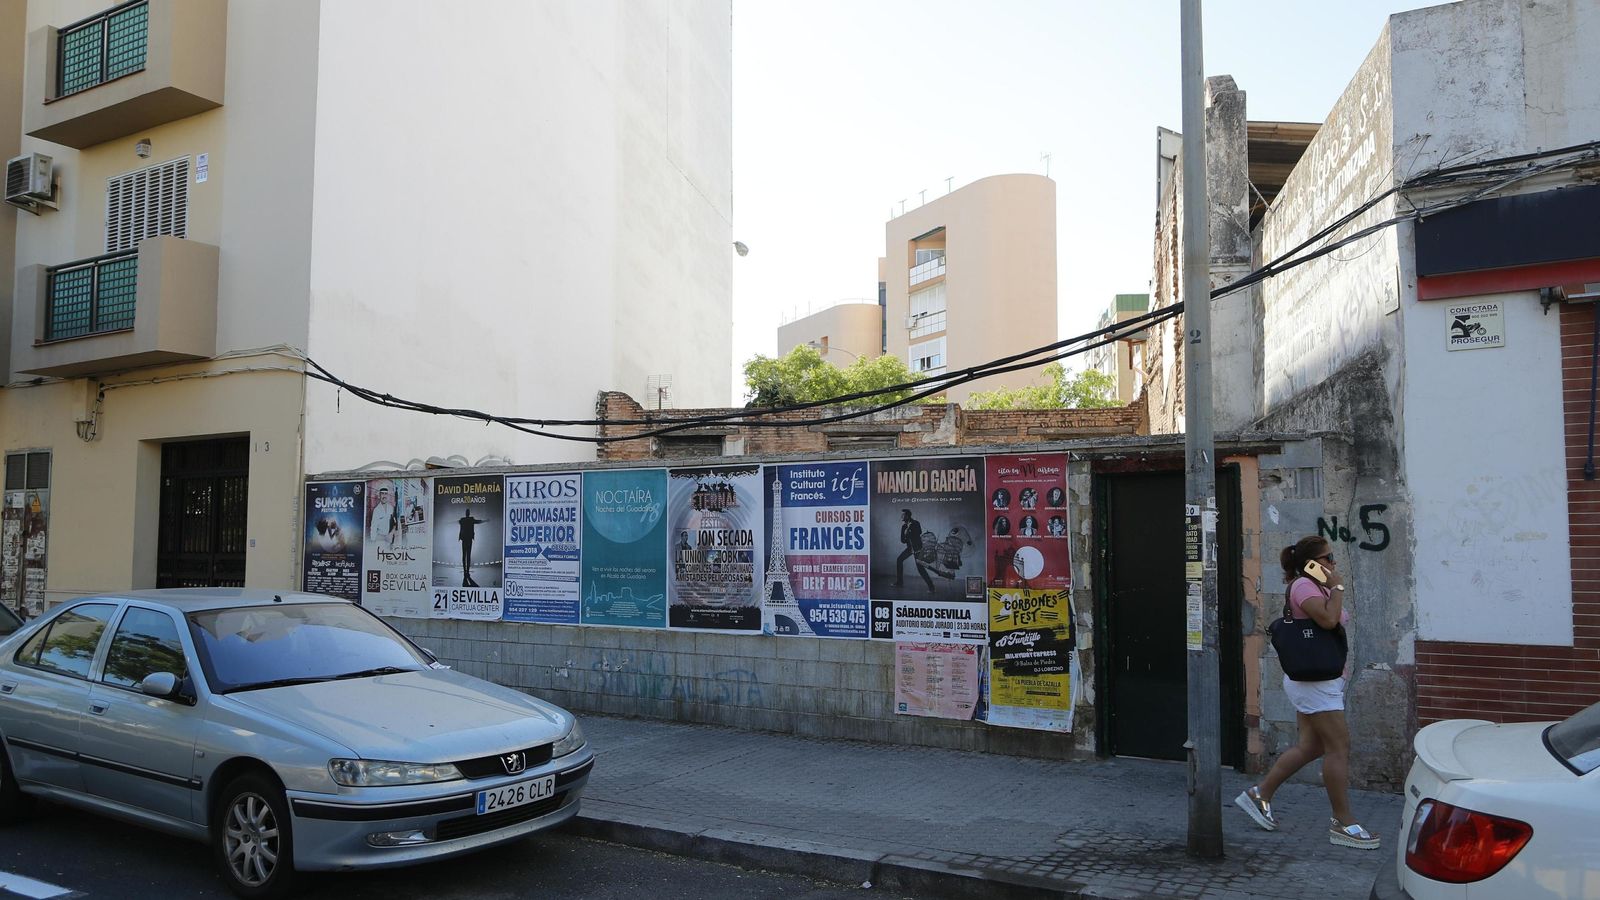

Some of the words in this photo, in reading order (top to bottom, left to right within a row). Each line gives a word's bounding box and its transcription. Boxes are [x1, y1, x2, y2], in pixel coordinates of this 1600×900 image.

[1450, 304, 1498, 314] CONECTADA
[1190, 329, 1202, 344] 2
[1451, 335, 1500, 344] PROSEGUR
[790, 470, 825, 478] Instituto
[831, 468, 862, 499] icf
[790, 481, 826, 489] Cultural
[877, 470, 928, 493] MANOLO
[930, 465, 977, 492] GARCÍA
[509, 480, 577, 499] KIROS
[596, 487, 653, 503] NOCTAÍRA
[790, 492, 826, 500] Francés.
[315, 496, 354, 509] SUMMER
[509, 507, 576, 526] QUIROMASAJE
[816, 511, 851, 523] CURSOS
[854, 510, 864, 522] DE
[511, 526, 575, 542] SUPERIOR
[1317, 516, 1357, 542] No.
[1359, 504, 1391, 552] 5
[698, 530, 714, 546] JON
[717, 530, 754, 546] SECADA
[790, 524, 864, 550] FRANCÉS
[675, 550, 684, 563] LA
[721, 551, 737, 563] OBK
[721, 564, 729, 573] LOS
[730, 564, 754, 573] INHUMANOS
[792, 565, 812, 573] CENTRO
[823, 565, 843, 573] EXAMEN
[844, 565, 865, 573] OFICIAL
[369, 573, 378, 582] 15
[676, 573, 707, 582] AMISTADES
[708, 574, 744, 582] PELIGROSAS
[803, 576, 825, 590] DELF
[827, 577, 851, 590] DALF
[367, 582, 379, 590] SEP
[382, 580, 427, 591] SEVILLA
[434, 594, 448, 609] 21
[452, 590, 499, 604] SEVILLA
[1004, 593, 1058, 611] CORBONES
[452, 603, 476, 611] CARTUJA
[875, 607, 889, 619] 08
[896, 605, 933, 618] SÁBADO
[935, 608, 971, 620] SEVILLA
[810, 609, 828, 622] 954
[829, 609, 848, 623] 539
[849, 610, 866, 624] 475
[1013, 608, 1041, 626] FEST
[875, 622, 889, 632] SEPT
[896, 620, 919, 628] AUDITORIO
[935, 620, 953, 630] JURADO
[971, 622, 987, 631] HORAS
[487, 786, 524, 810] 2426
[529, 778, 553, 799] CLR
